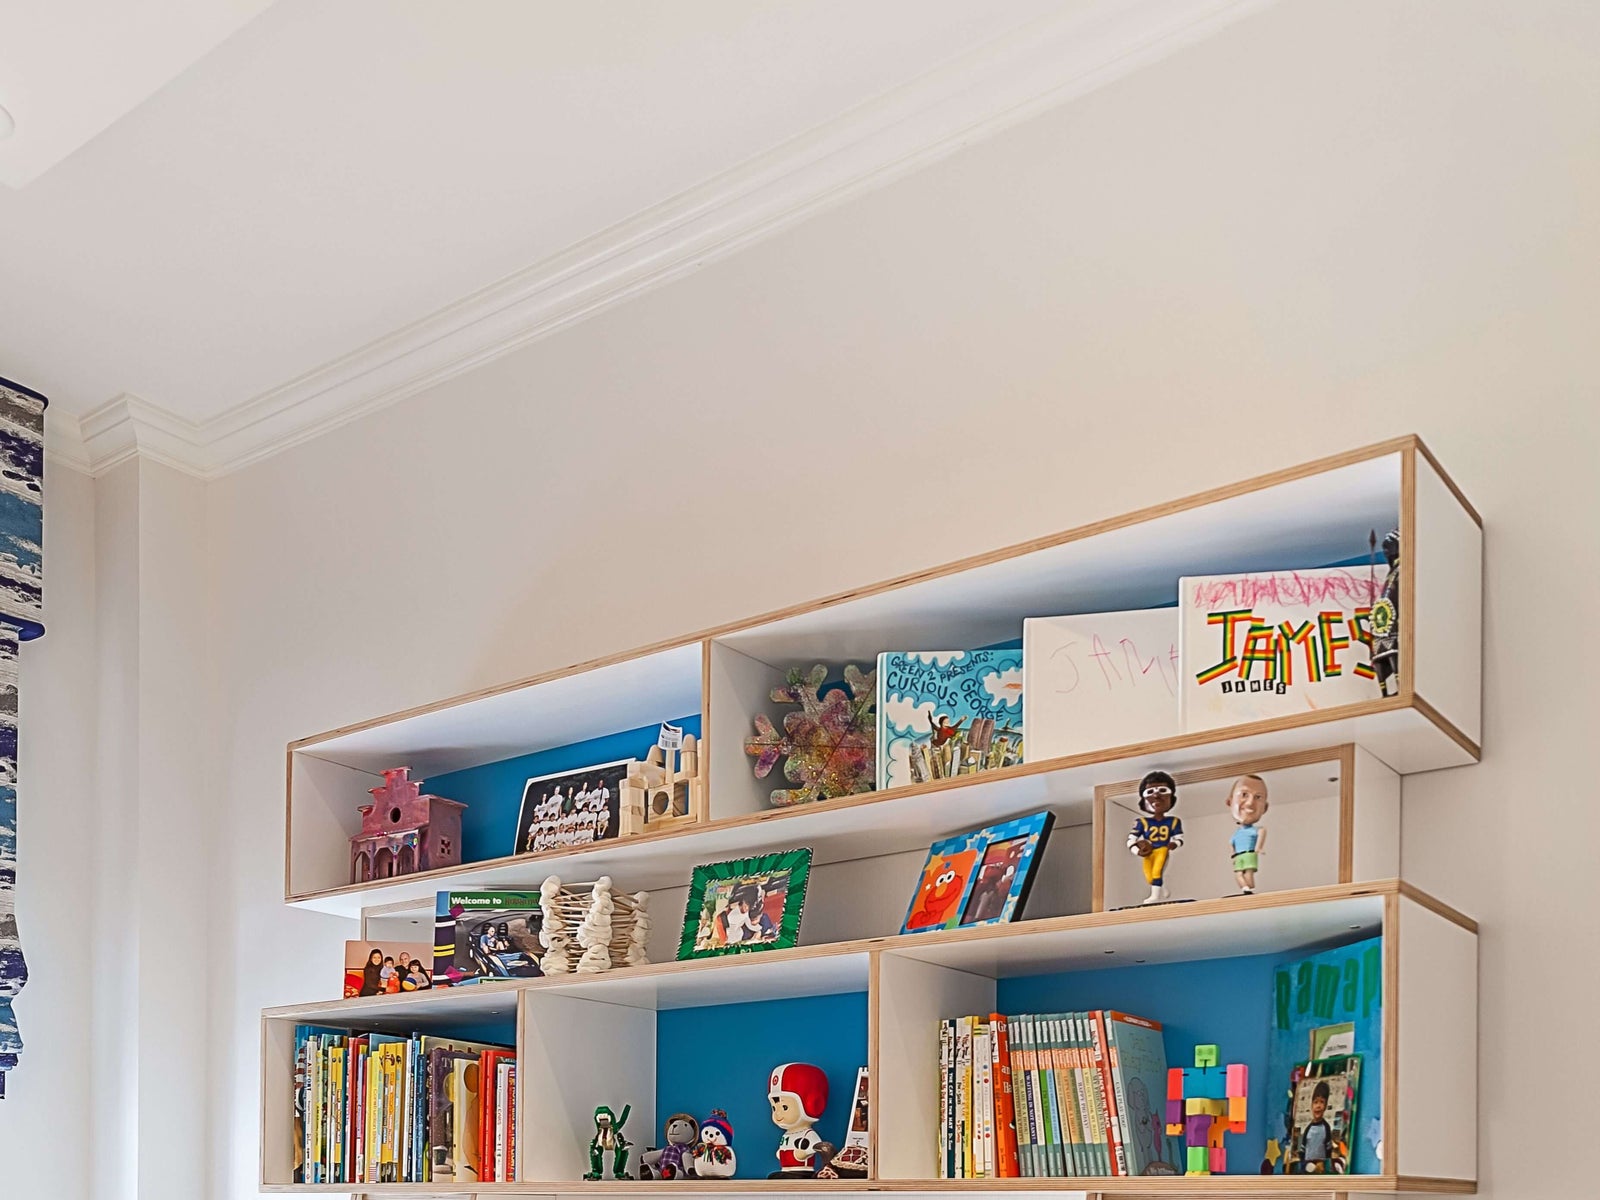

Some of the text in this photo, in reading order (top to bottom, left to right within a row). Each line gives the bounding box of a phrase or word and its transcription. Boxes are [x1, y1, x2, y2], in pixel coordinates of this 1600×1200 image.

[1196, 607, 1377, 686] JAMES
[891, 651, 994, 683] GREEN 2 PRESENTS:
[887, 671, 1005, 722] CURIOUS GEORGE
[1221, 679, 1286, 694] JAMES
[1149, 825, 1169, 841] 29
[451, 896, 490, 905] Welcome
[493, 897, 502, 905] to
